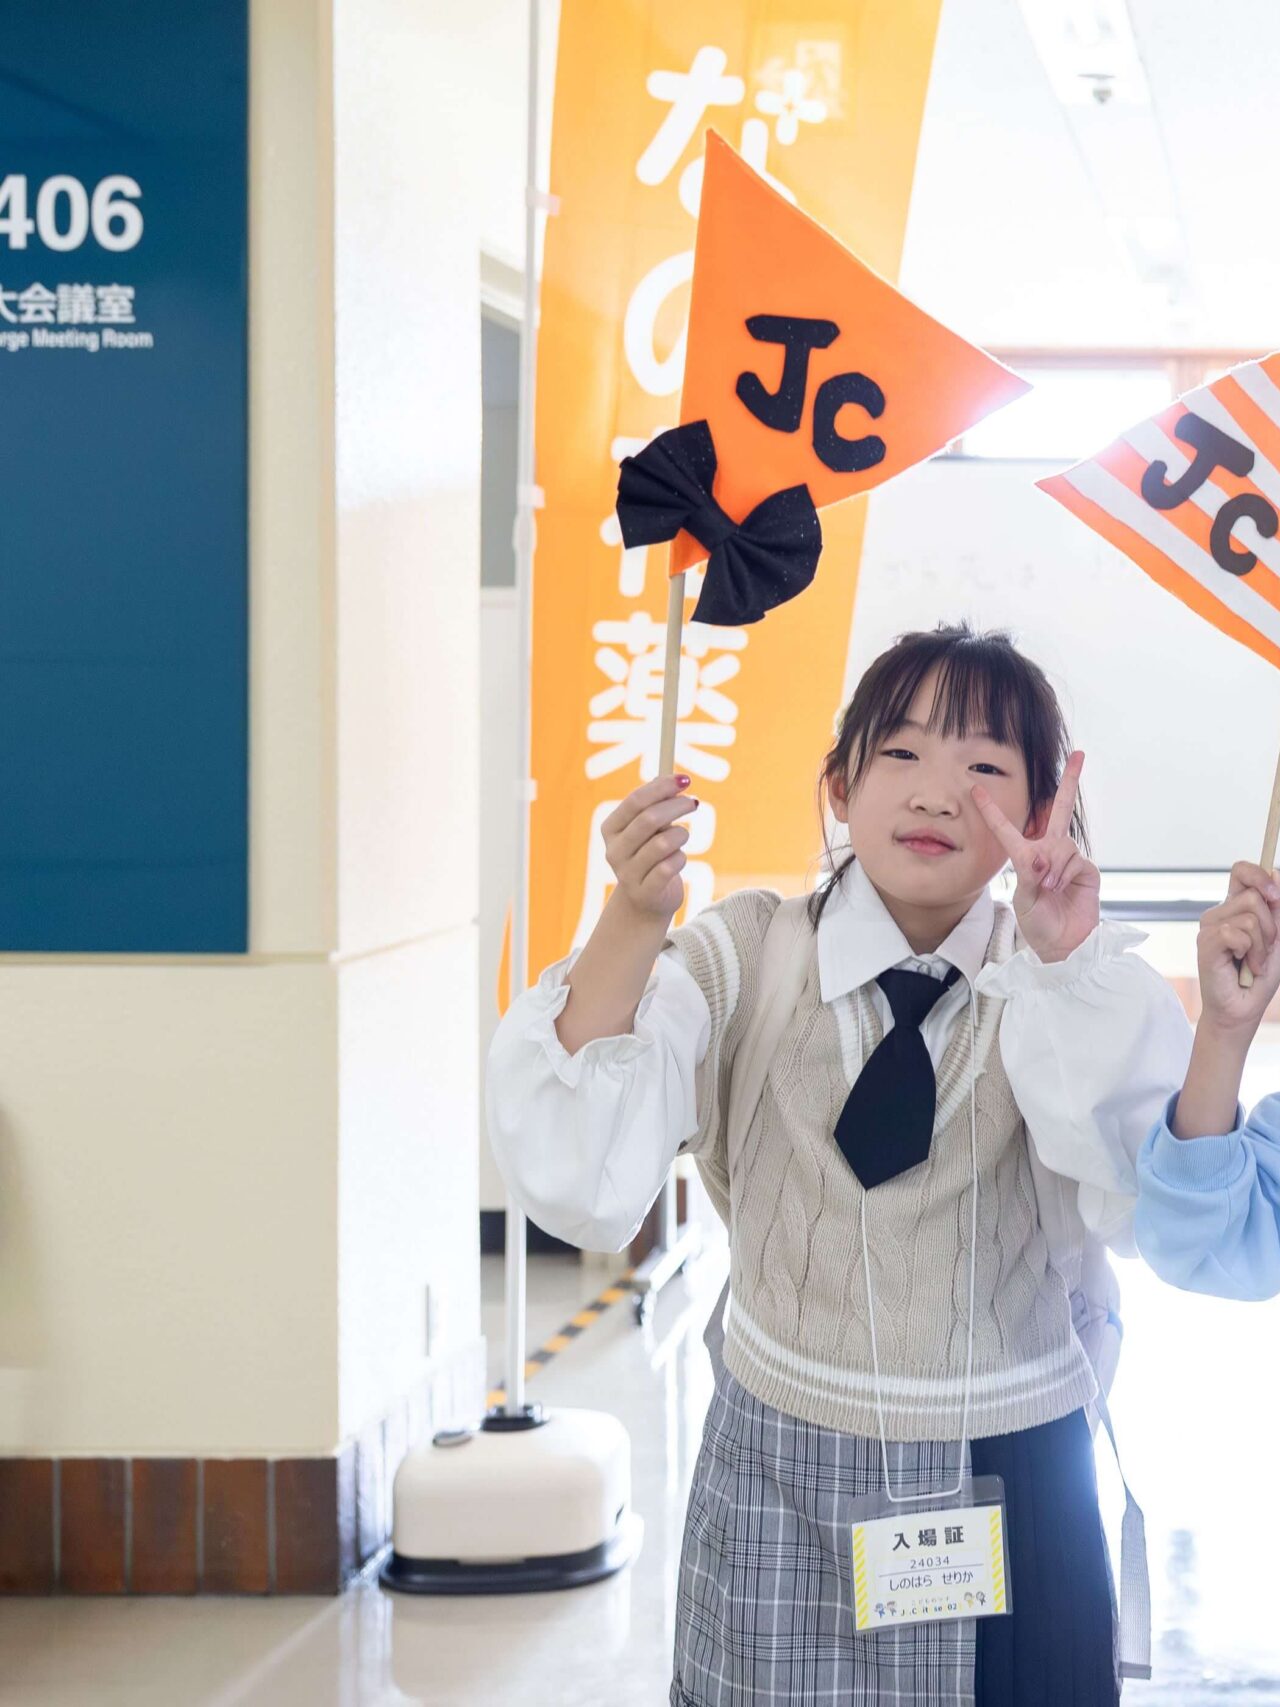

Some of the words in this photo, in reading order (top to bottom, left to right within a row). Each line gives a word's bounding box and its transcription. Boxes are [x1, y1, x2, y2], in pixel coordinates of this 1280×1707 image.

[0, 174, 144, 252] 406
[31, 327, 100, 352] Meeting
[101, 327, 154, 348] Room
[735, 313, 887, 473] JC
[1141, 411, 1279, 576] JC
[893, 1525, 964, 1552] 入場証
[910, 1555, 950, 1569] 24034
[889, 1574, 933, 1591] しのはら
[942, 1570, 974, 1585] せりか
